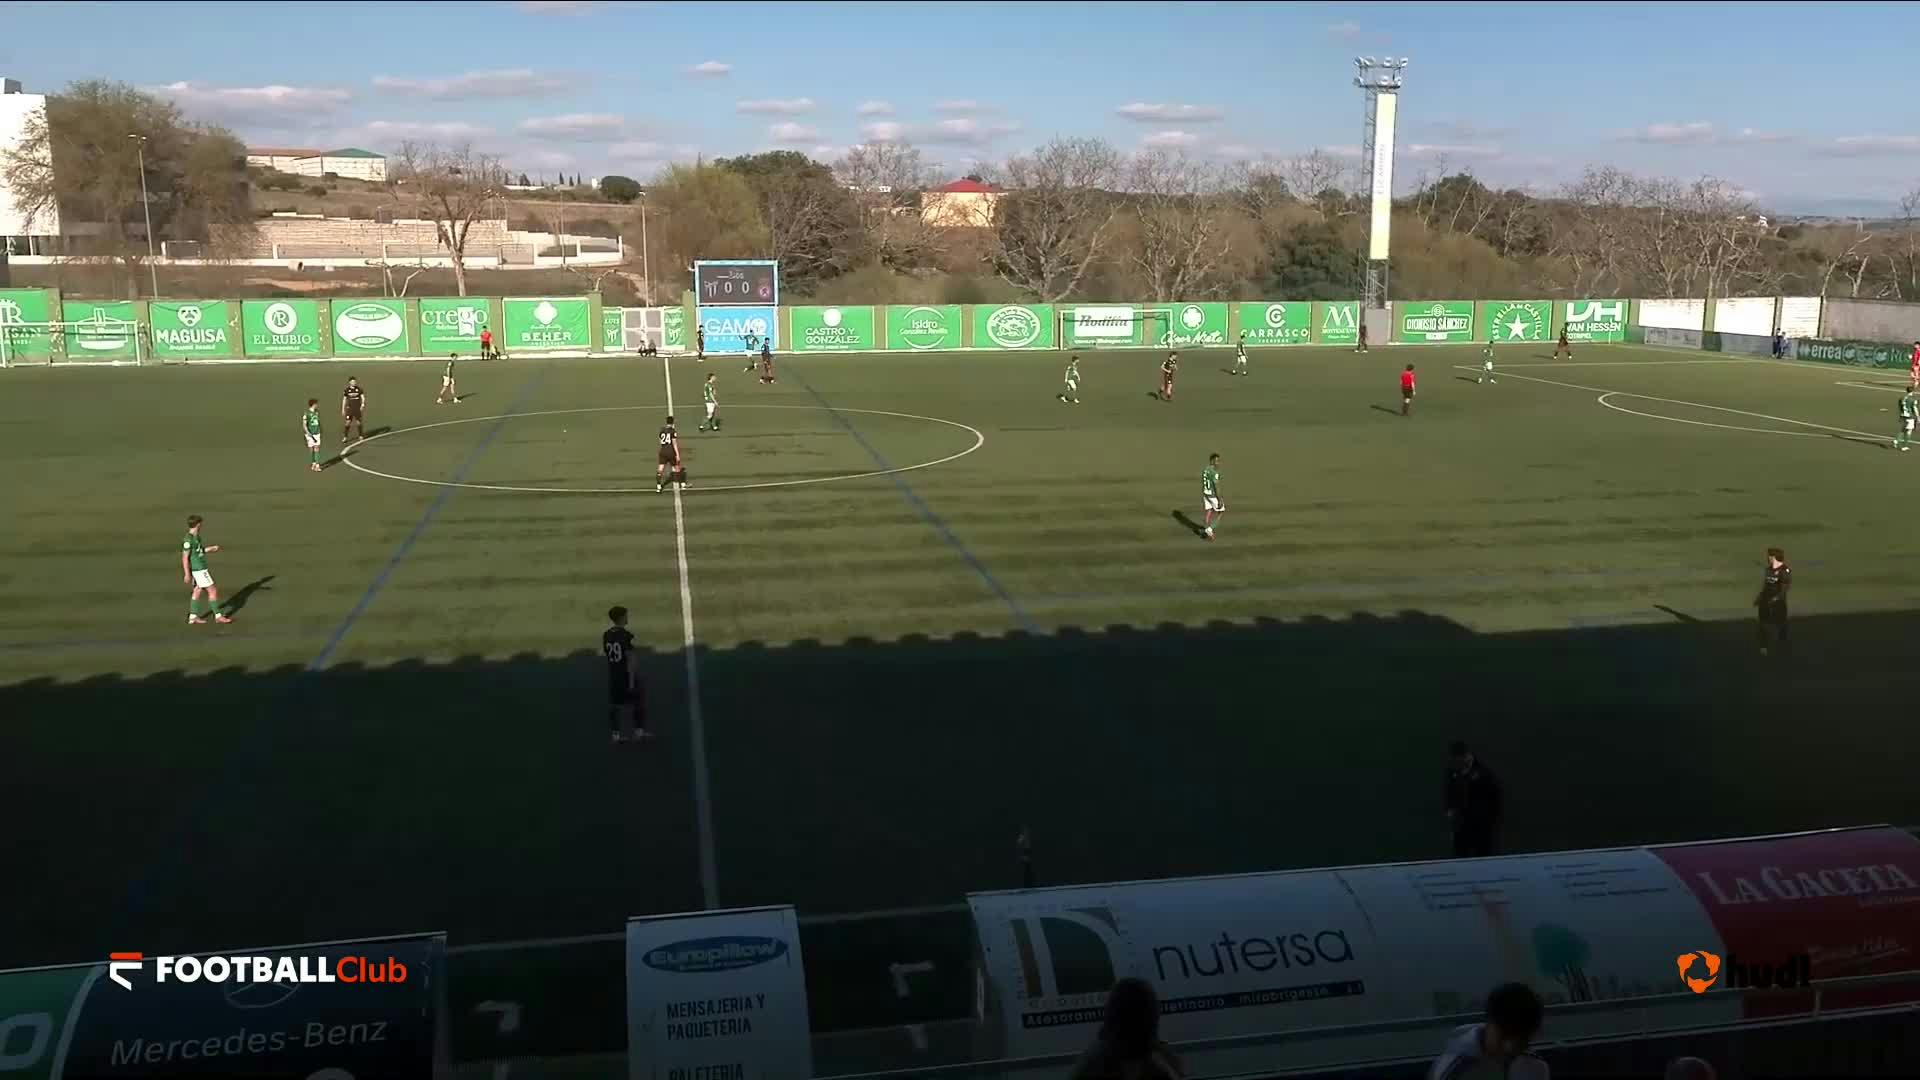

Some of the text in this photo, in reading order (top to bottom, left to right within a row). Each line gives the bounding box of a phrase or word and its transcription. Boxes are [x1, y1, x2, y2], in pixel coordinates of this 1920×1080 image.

[724, 281, 750, 294] 0 0
[421, 308, 488, 330] crego
[912, 319, 938, 329] Isidro
[1406, 317, 1437, 330] DIONISIO
[805, 327, 855, 336] CASTRO Y
[1240, 328, 1309, 337] CARRASCO
[1586, 322, 1621, 332] HESSEN
[156, 328, 226, 344] MAGUISA
[253, 334, 312, 345] EL RUBIO
[521, 331, 572, 342] BEHER
[660, 432, 672, 445] 24
[607, 641, 622, 662] 29
[1697, 872, 1769, 904] LA
[1760, 863, 1920, 901] GACETA
[1153, 929, 1355, 981] nutersa
[666, 993, 766, 1019] MENSAJERIA Y
[667, 1018, 752, 1041] PAQUETERIA
[110, 1017, 389, 1066] Mercedes-Benz
